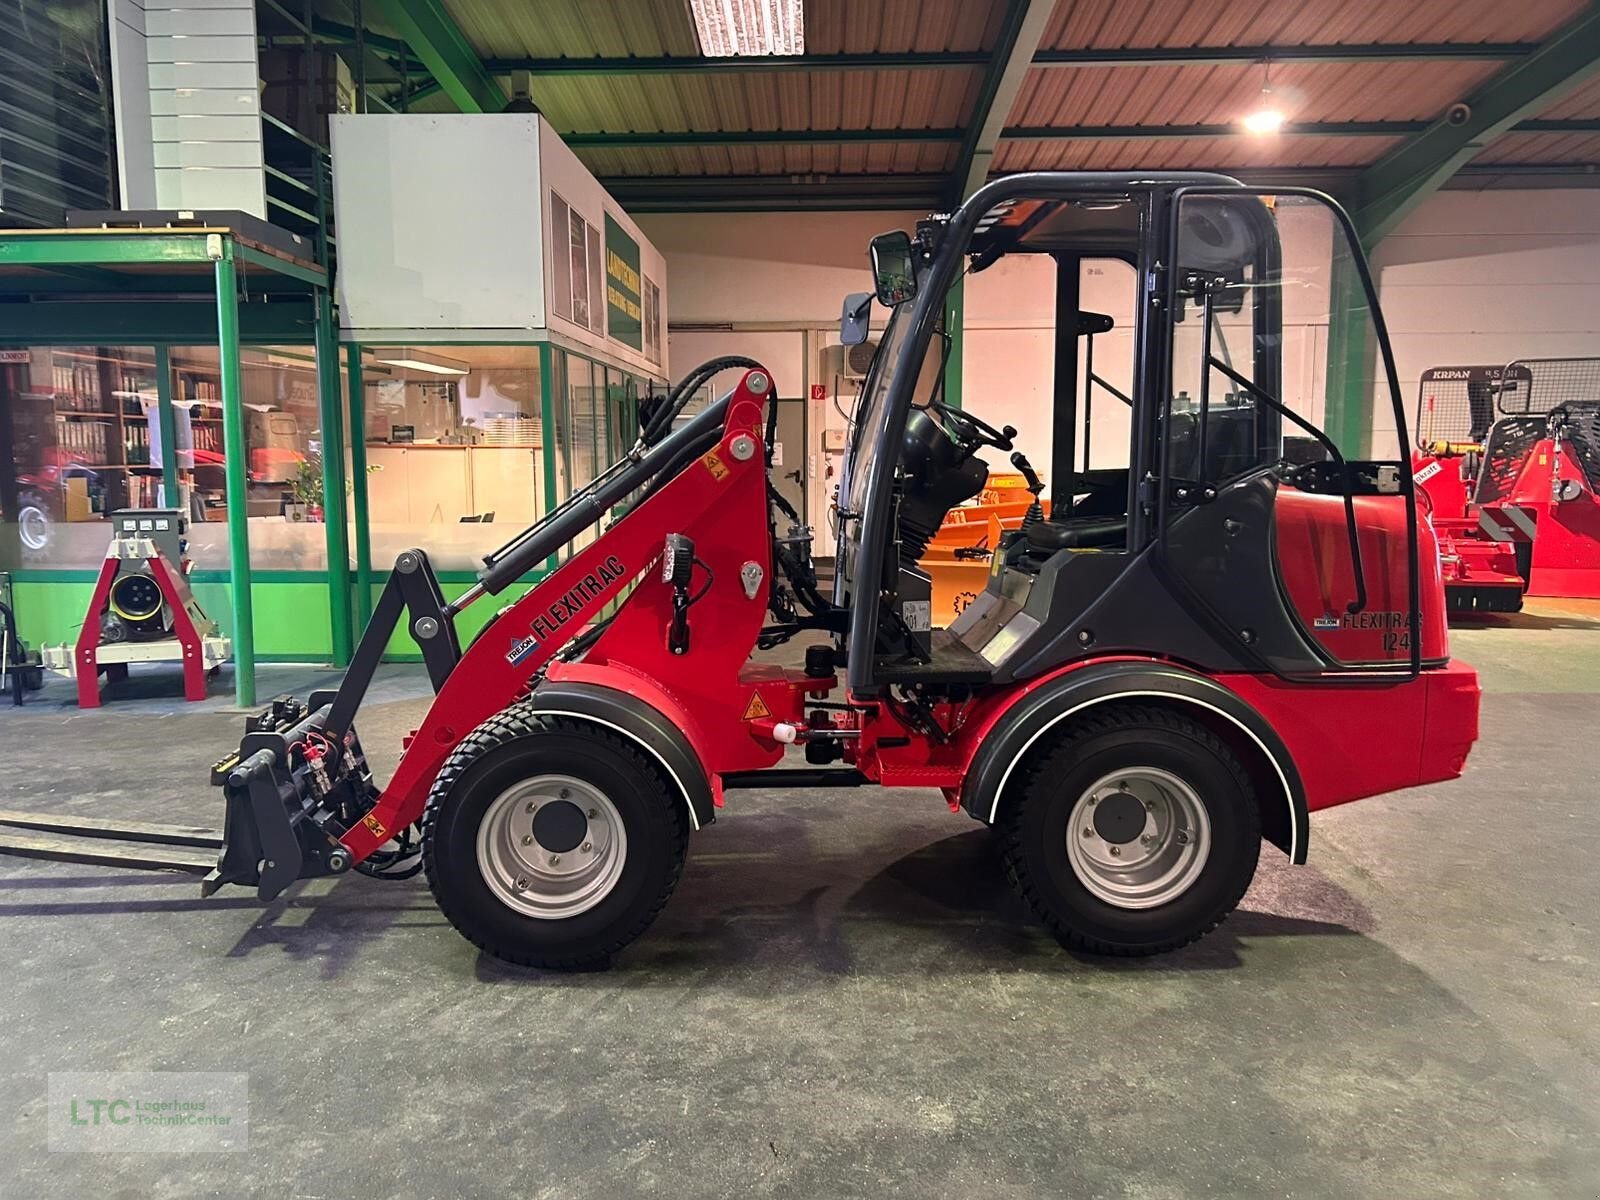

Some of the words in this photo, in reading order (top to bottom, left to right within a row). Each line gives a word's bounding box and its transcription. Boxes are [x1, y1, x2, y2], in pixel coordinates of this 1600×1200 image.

[1433, 370, 1471, 379] KRPAN
[531, 556, 625, 639] FLEXITRAC
[507, 638, 533, 660] TREJON
[1383, 632, 1421, 650] 124
